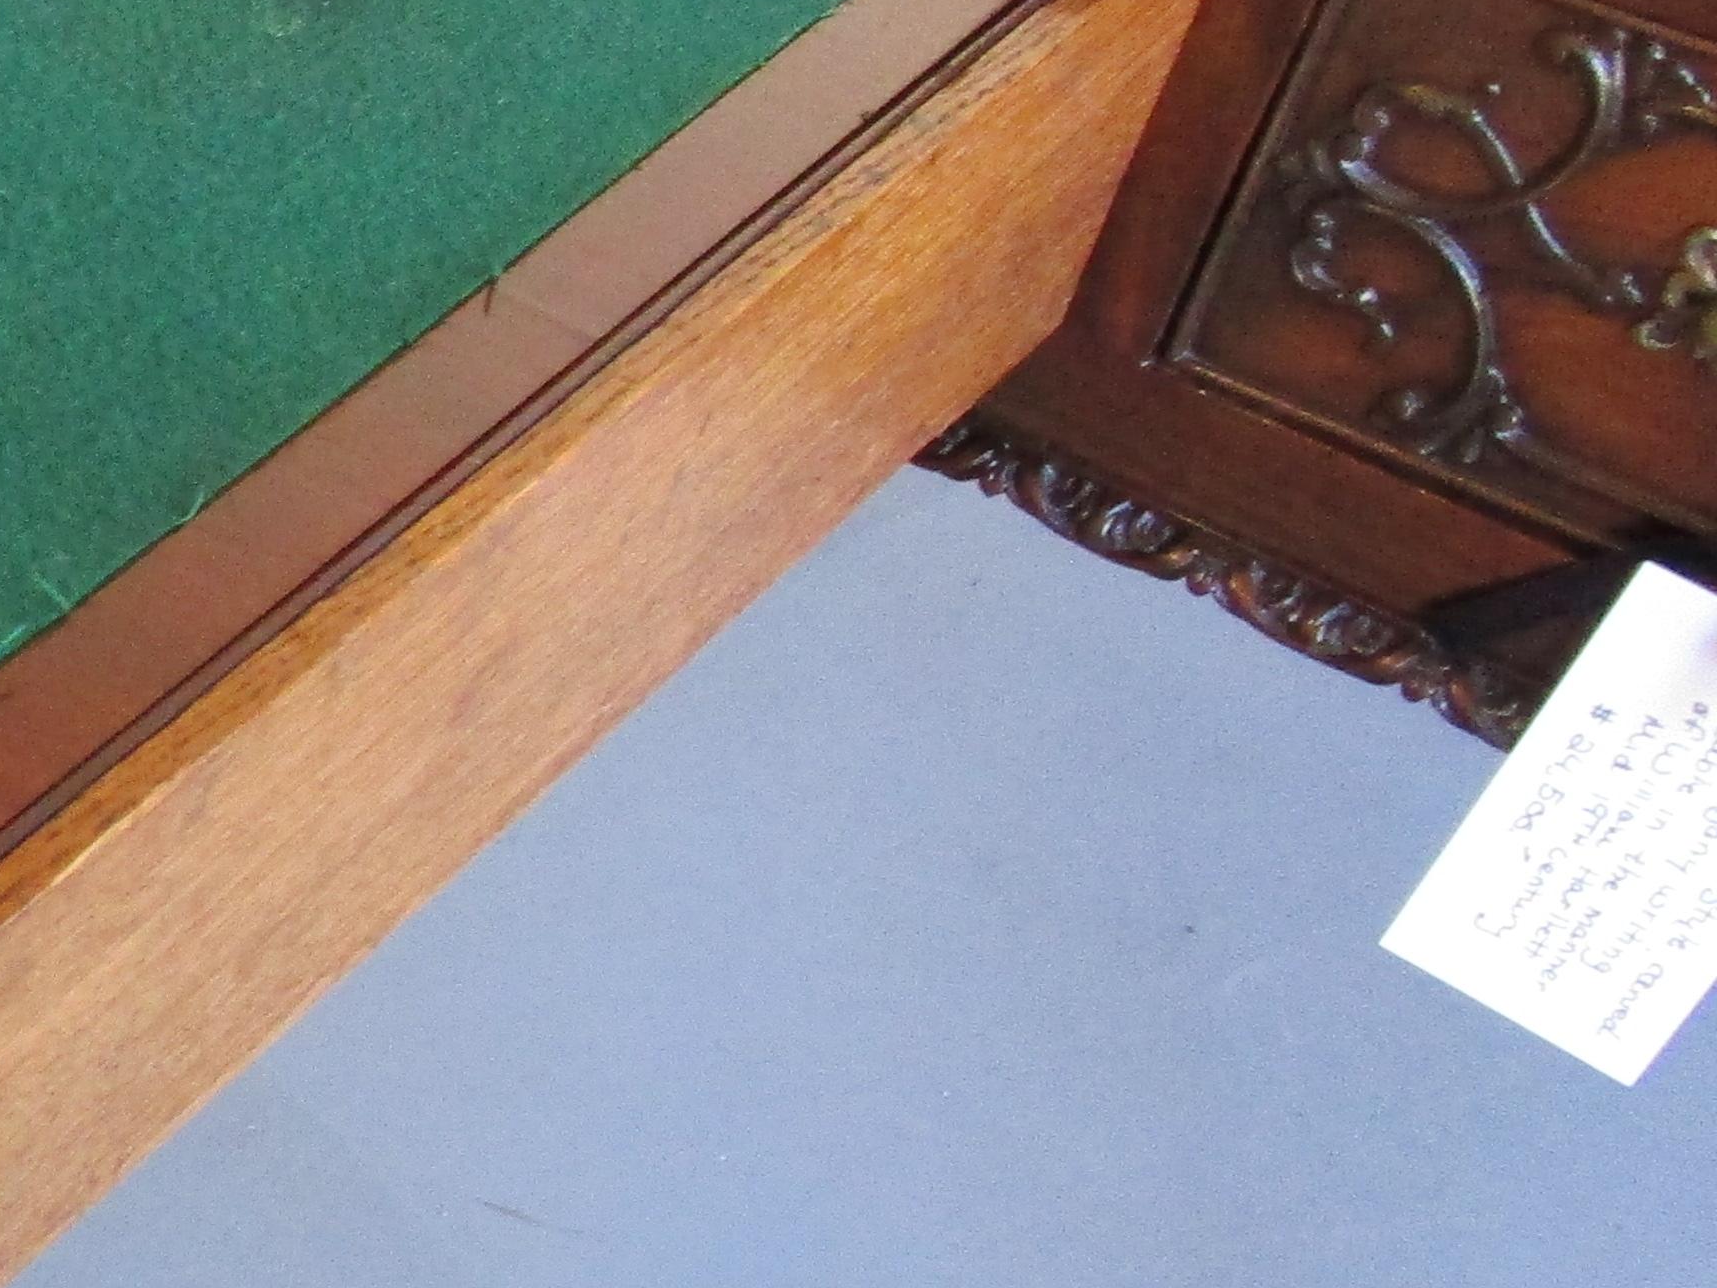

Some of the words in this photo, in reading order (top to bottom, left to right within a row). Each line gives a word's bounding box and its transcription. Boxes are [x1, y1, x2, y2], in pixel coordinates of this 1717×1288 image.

[1646, 807, 1676, 833] in
[1665, 806, 1717, 874] any
[1603, 852, 1646, 891] the
[1580, 885, 1673, 974] writing
